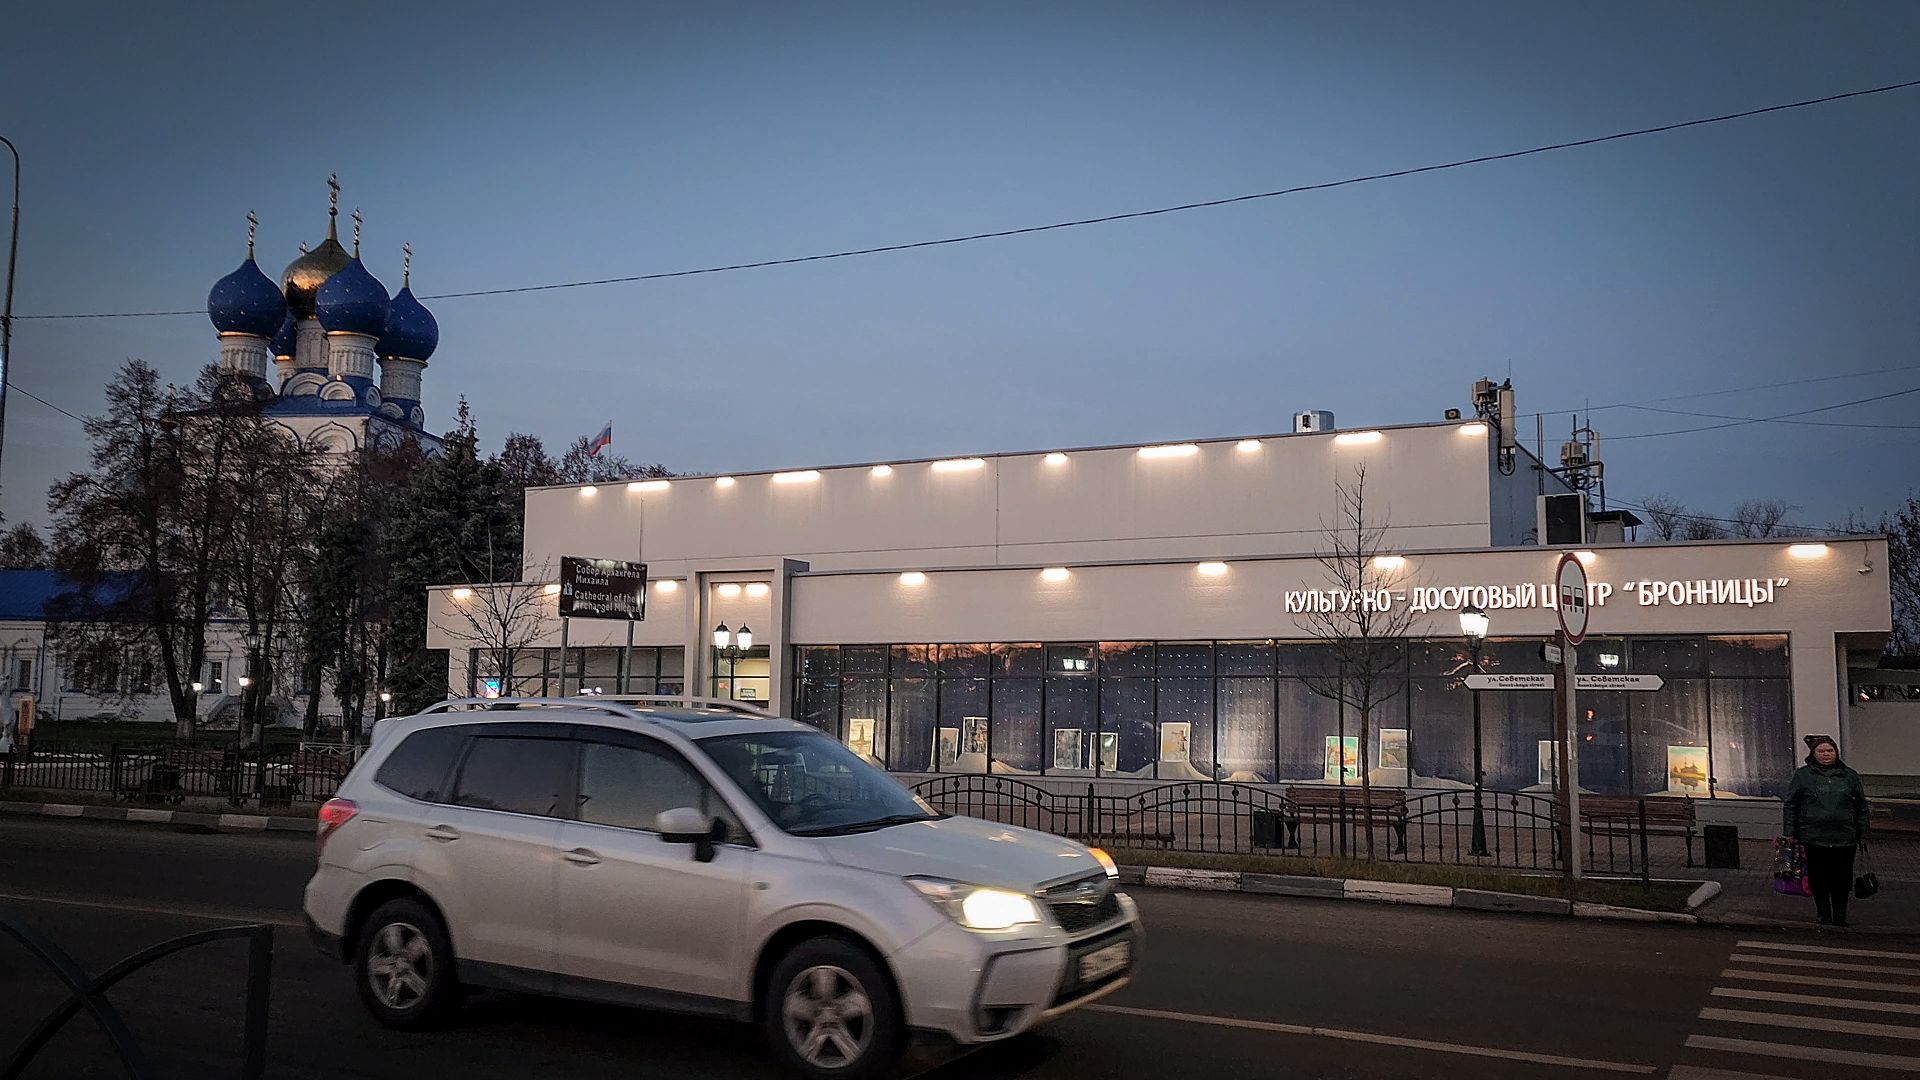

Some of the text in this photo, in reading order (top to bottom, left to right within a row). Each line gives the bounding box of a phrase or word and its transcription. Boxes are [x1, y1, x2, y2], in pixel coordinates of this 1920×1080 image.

[576, 565, 640, 579] Собор Архангела
[575, 575, 609, 586] Михаила
[574, 590, 635, 603] Cathedral of the
[1285, 589, 1391, 613] КУЛЬТУРНО
[1410, 582, 1537, 614] ДОСУГОВЫЙ
[1541, 582, 1613, 611] ЦТР
[1590, 675, 1640, 683] Советская
